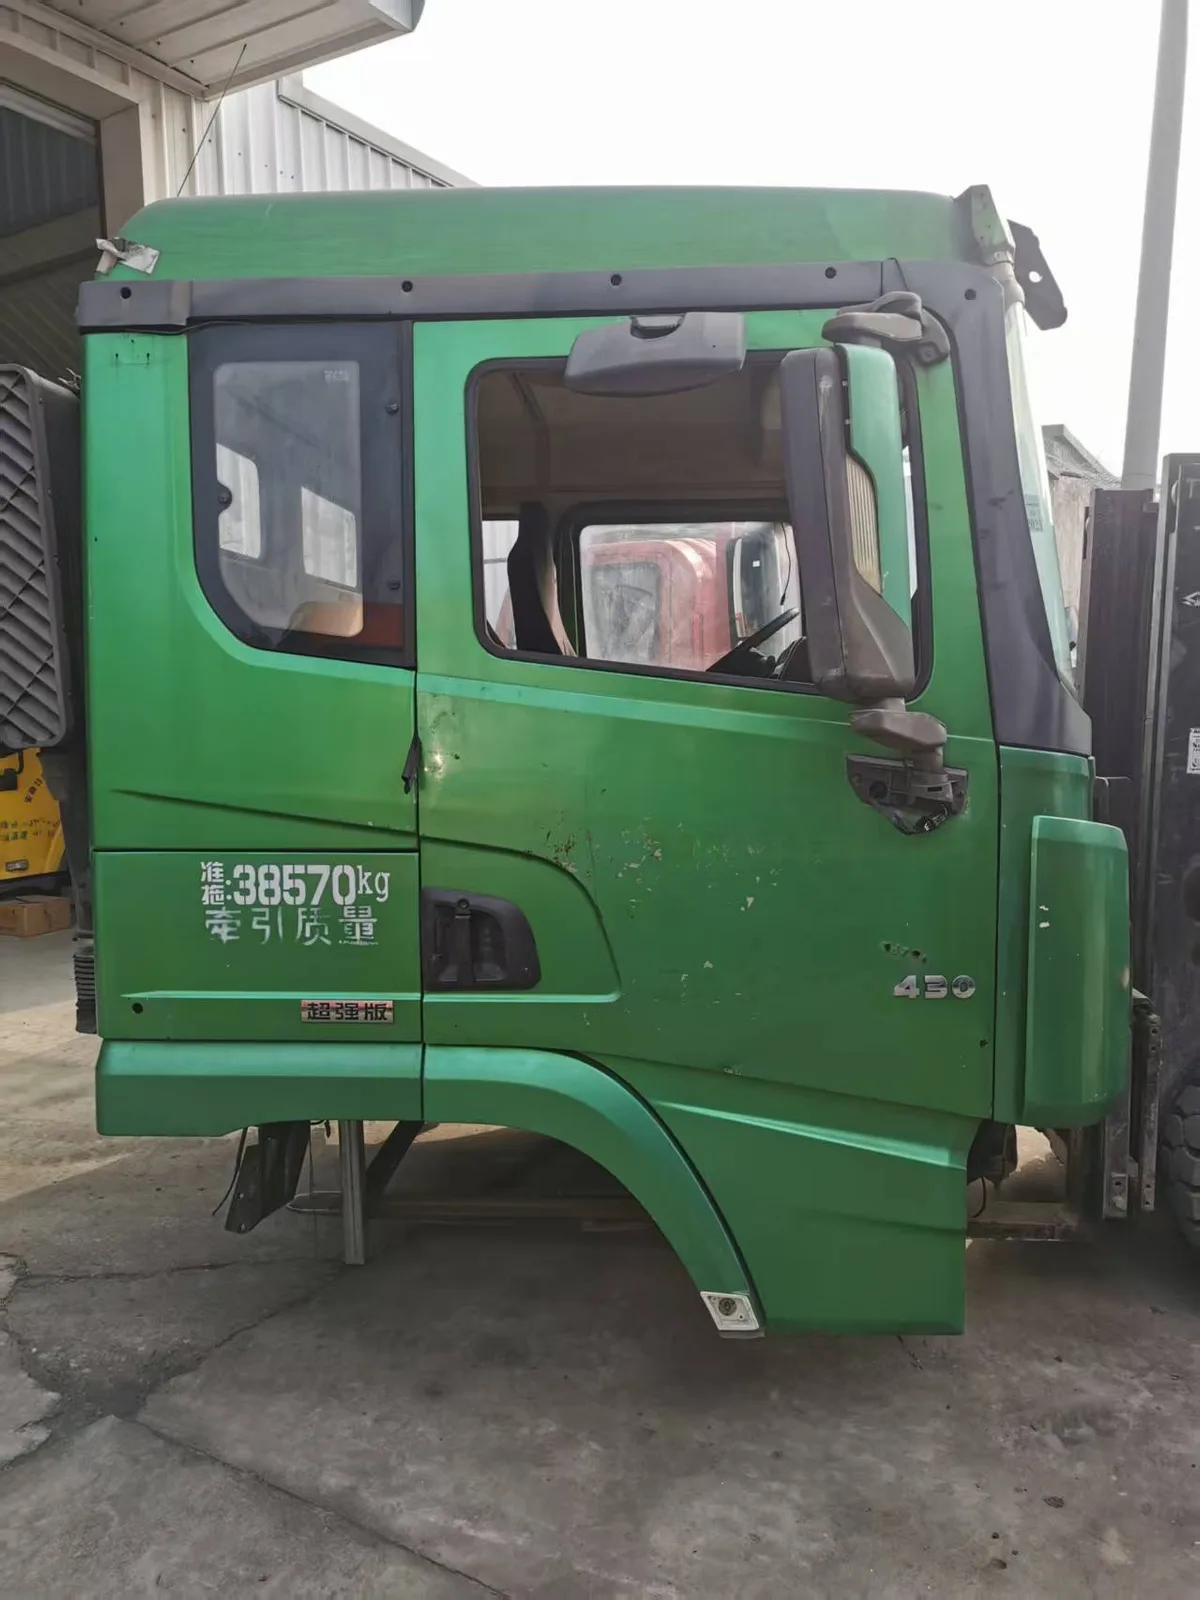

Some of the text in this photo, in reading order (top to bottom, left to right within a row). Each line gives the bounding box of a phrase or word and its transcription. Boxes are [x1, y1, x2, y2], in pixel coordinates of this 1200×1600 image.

[205, 906, 379, 946] 牵引质量
[893, 974, 976, 999] 430
[307, 1002, 387, 1021] 超强版
